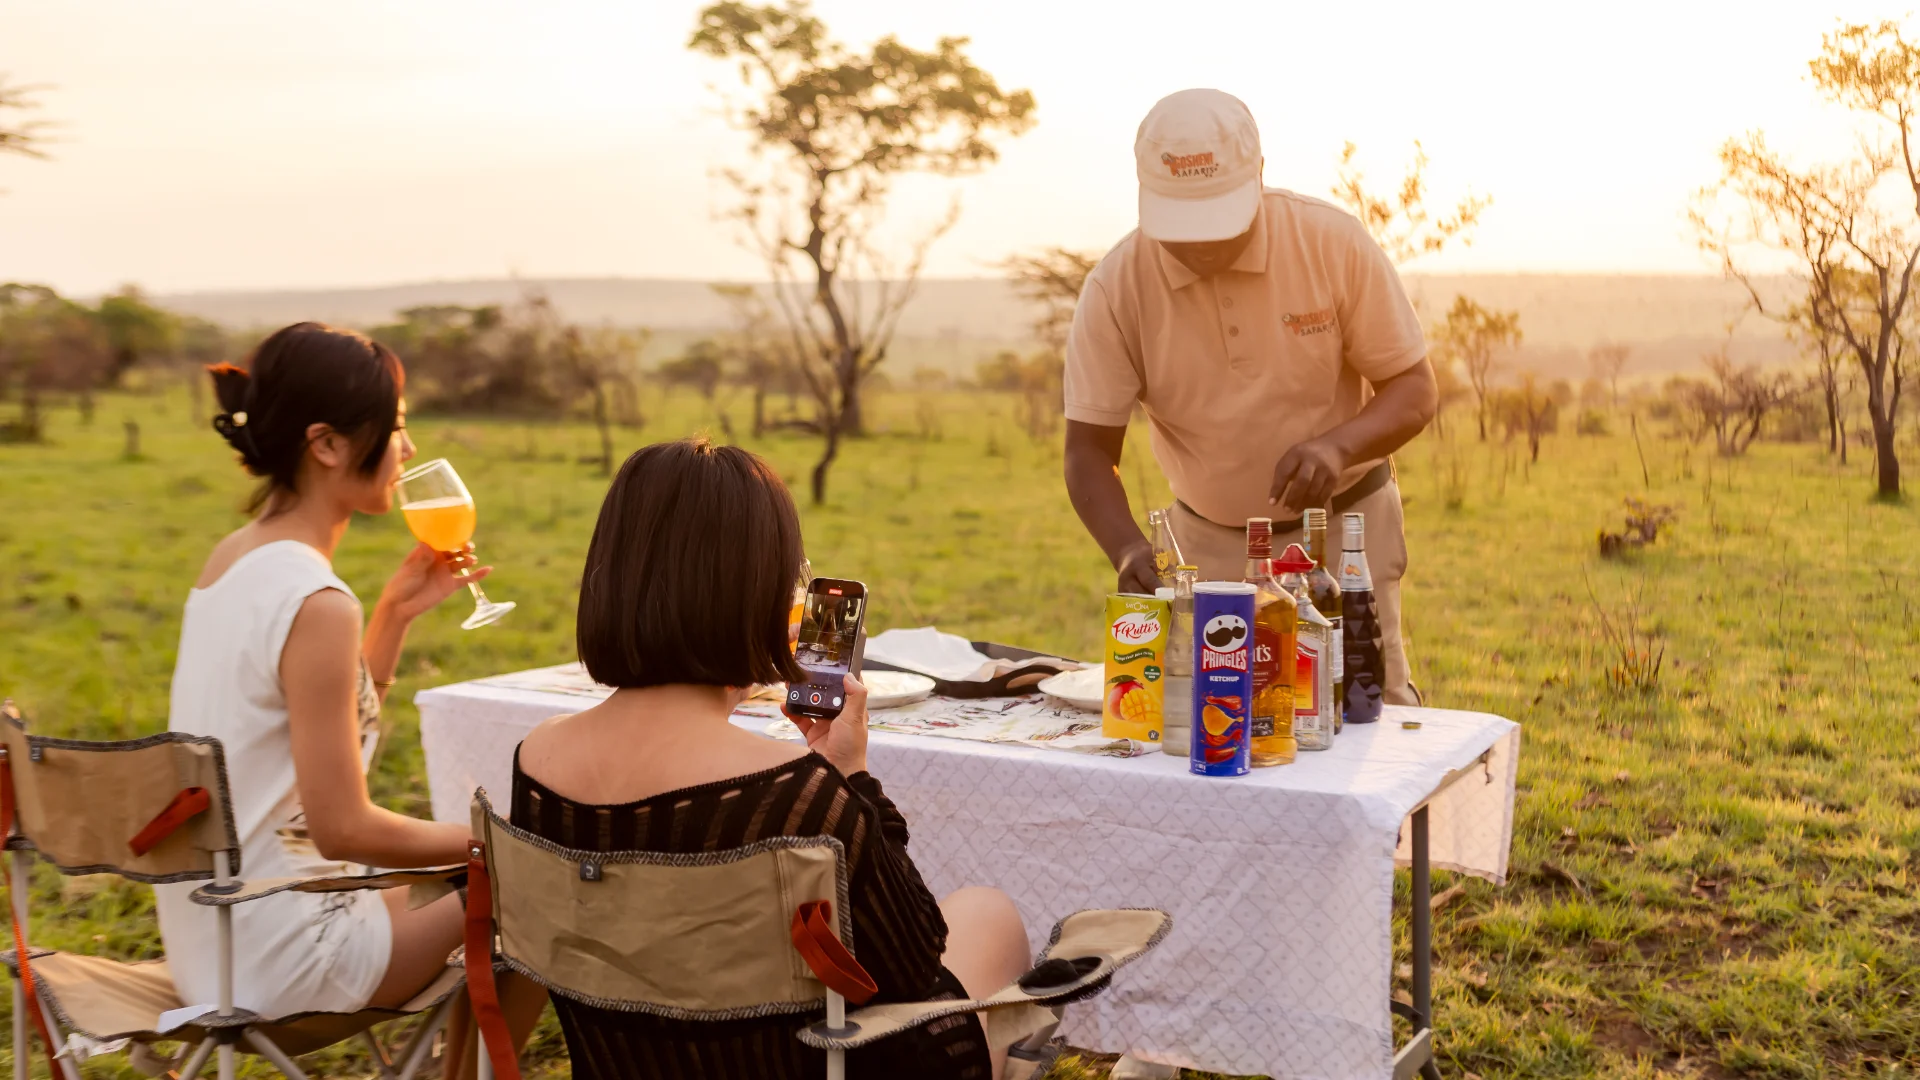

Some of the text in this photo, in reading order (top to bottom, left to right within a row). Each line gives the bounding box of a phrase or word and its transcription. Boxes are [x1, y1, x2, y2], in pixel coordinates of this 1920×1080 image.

[1177, 167, 1214, 177] SAFARIS
[1203, 648, 1247, 671] PRINGLES
[1209, 675, 1240, 683] KETCHUP
